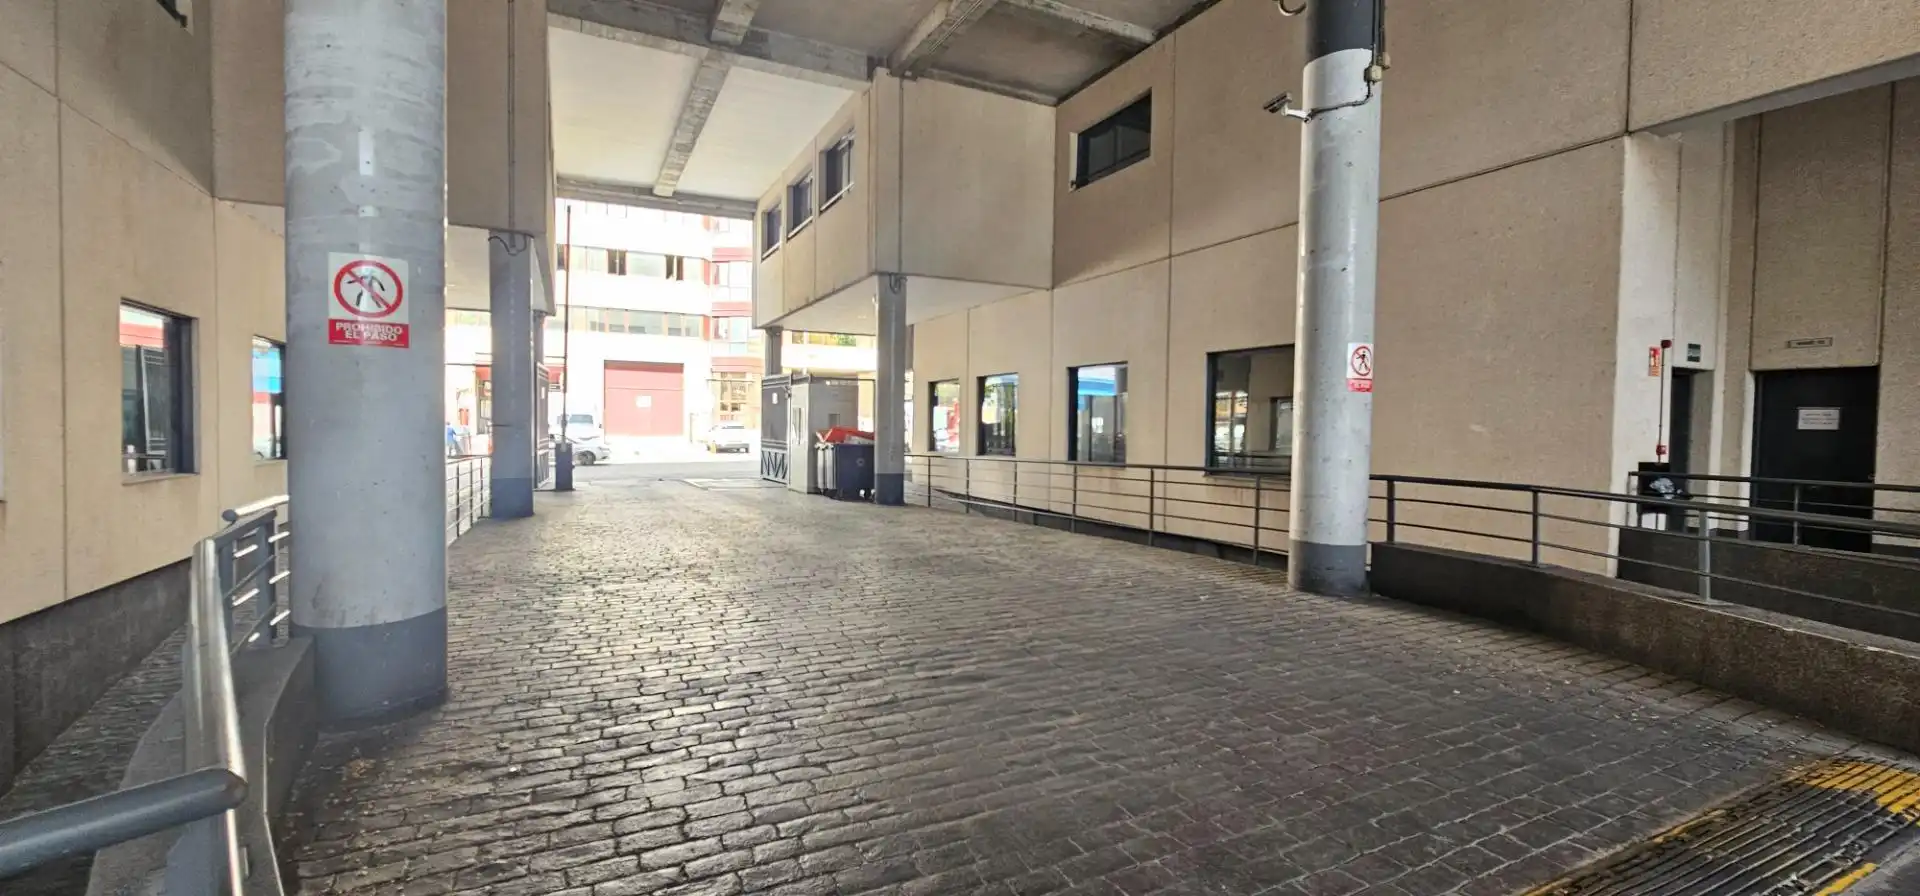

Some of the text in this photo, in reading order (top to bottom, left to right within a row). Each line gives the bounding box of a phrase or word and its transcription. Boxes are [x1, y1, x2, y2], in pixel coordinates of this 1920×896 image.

[336, 322, 402, 335] PROHIBIDO
[345, 331, 398, 341] EL PASO
